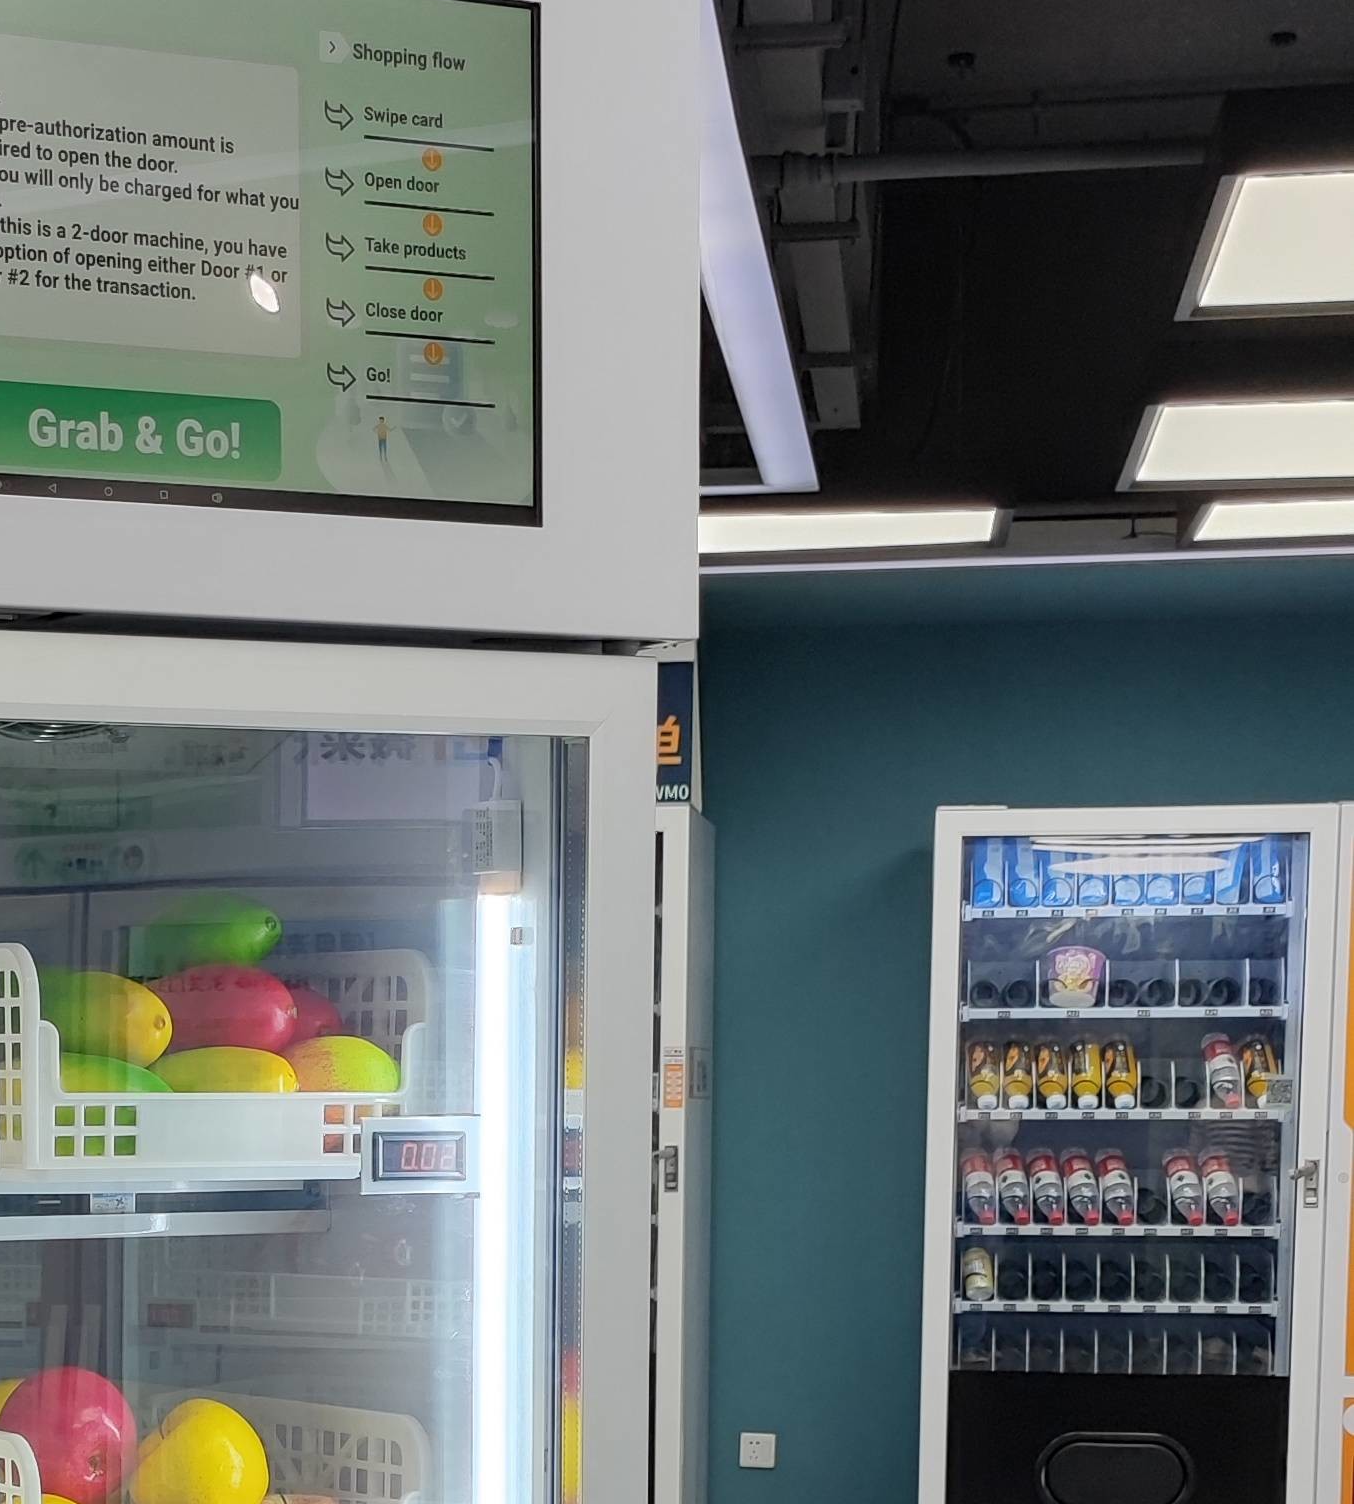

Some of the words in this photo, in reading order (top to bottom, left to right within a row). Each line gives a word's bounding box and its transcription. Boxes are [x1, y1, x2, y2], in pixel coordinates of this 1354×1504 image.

[352, 42, 428, 71] Shopping
[432, 51, 466, 72] flow
[363, 106, 408, 128] Swipe
[411, 113, 444, 129] card
[152, 132, 216, 152] amount
[220, 136, 235, 154] is
[36, 144, 53, 161] to
[58, 149, 99, 167] open
[104, 150, 132, 169] the
[136, 153, 178, 173] door.
[24, 168, 53, 187] will
[58, 172, 94, 195] only
[99, 174, 120, 193] be
[124, 178, 192, 203] charged
[197, 184, 221, 202] for
[225, 188, 266, 207] what
[270, 193, 300, 212] you
[364, 171, 402, 191] Open
[406, 175, 440, 193] door
[0, 216, 32, 236] this
[37, 219, 51, 238] is
[56, 225, 67, 239] a
[71, 223, 129, 244] 2-door
[133, 231, 209, 255] machine,
[213, 239, 243, 257] you
[248, 238, 288, 259] have
[364, 236, 400, 255] Take
[403, 242, 467, 261] products
[53, 247, 71, 265] of
[75, 252, 143, 275] opening
[147, 256, 196, 275] either
[201, 259, 240, 279] Door
[270, 269, 288, 284] or
[7, 268, 30, 286] #2
[35, 270, 59, 289] for
[64, 273, 92, 292] the
[96, 277, 197, 300] transaction.
[365, 302, 406, 319] Close
[410, 305, 444, 323] door
[366, 366, 391, 383] Go!
[28, 408, 124, 452] Grab
[134, 415, 165, 455] &
[175, 418, 241, 461] Go!
